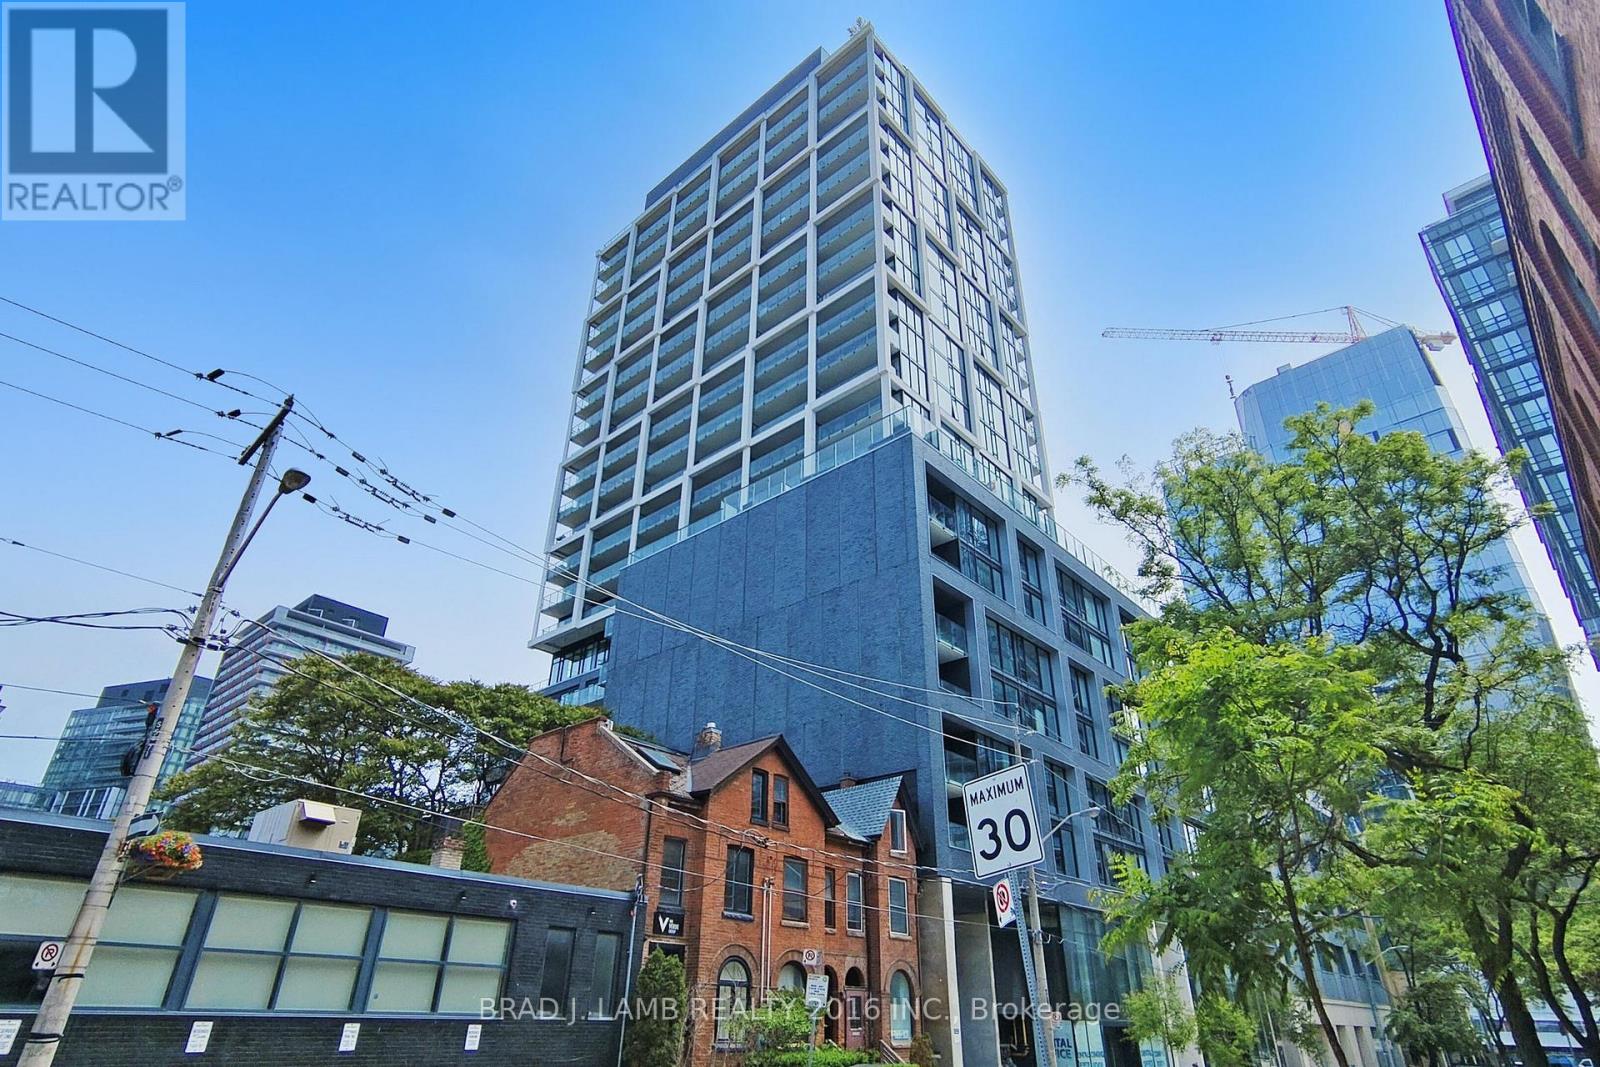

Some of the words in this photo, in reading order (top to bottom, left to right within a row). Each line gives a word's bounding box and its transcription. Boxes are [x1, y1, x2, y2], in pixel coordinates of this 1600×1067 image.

[969, 776, 1024, 807] MAXIMUM
[977, 808, 1031, 861] 30
[1054, 1038, 1072, 1048] TAL
[1055, 1049, 1072, 1059] ICE
